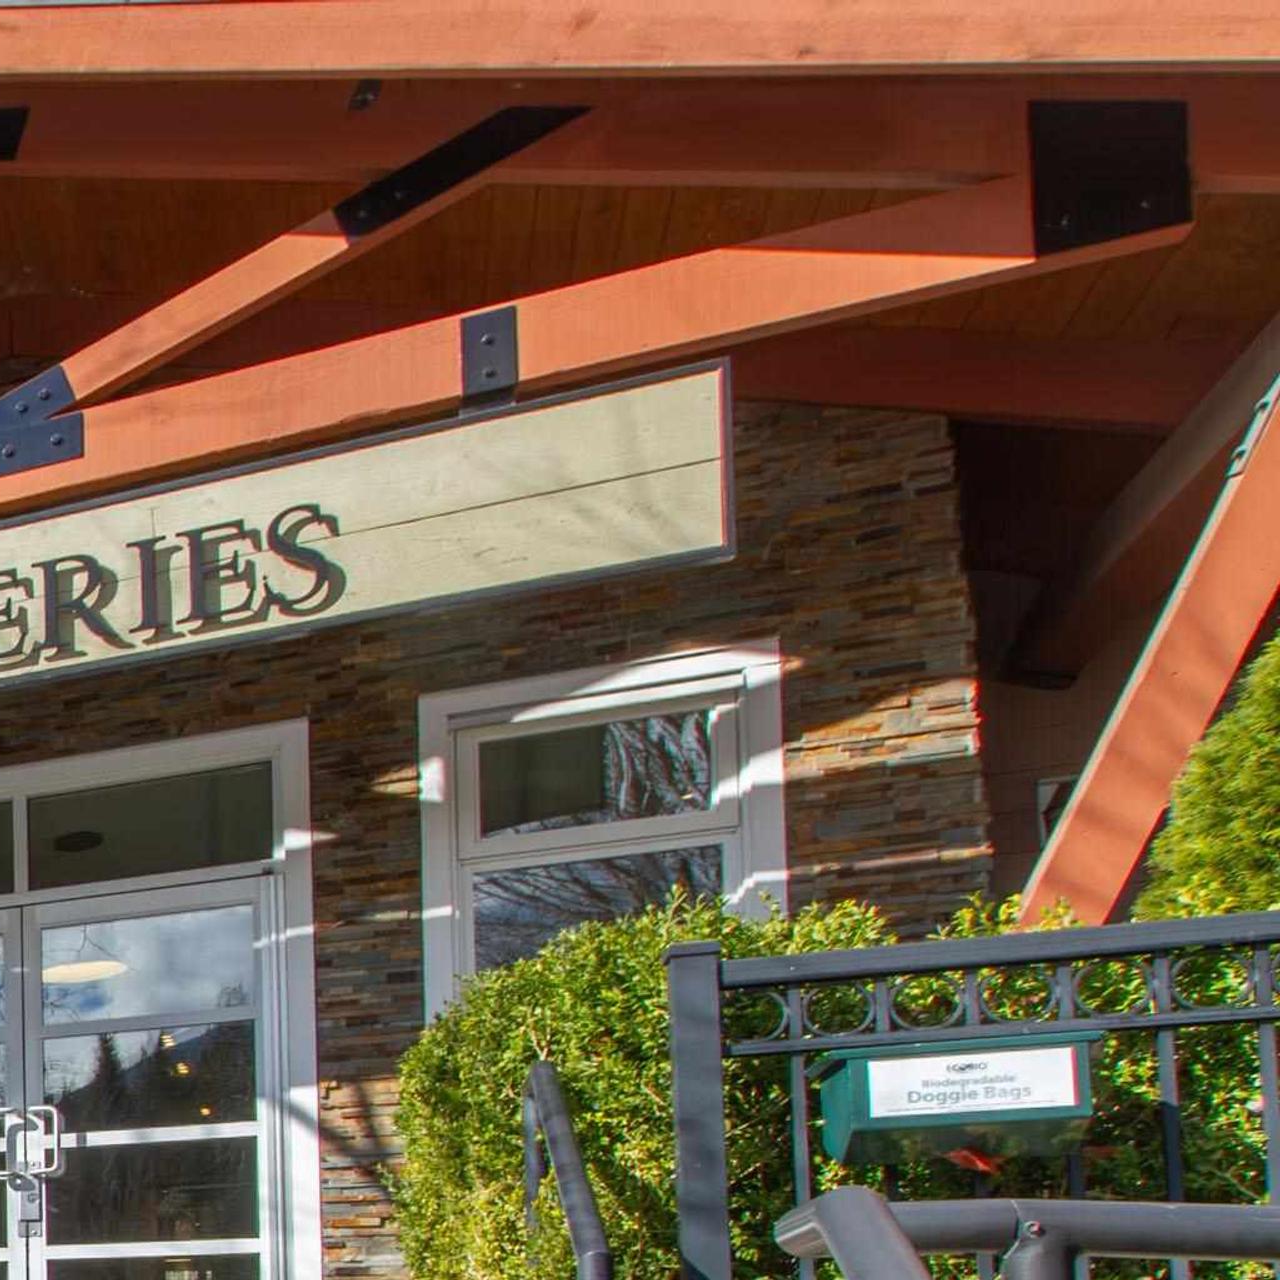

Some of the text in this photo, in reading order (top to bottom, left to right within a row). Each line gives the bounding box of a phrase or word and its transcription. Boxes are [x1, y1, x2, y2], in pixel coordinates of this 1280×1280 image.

[921, 1074, 1017, 1089] Biodegradable
[906, 1084, 1033, 1105] Doggie Bags
